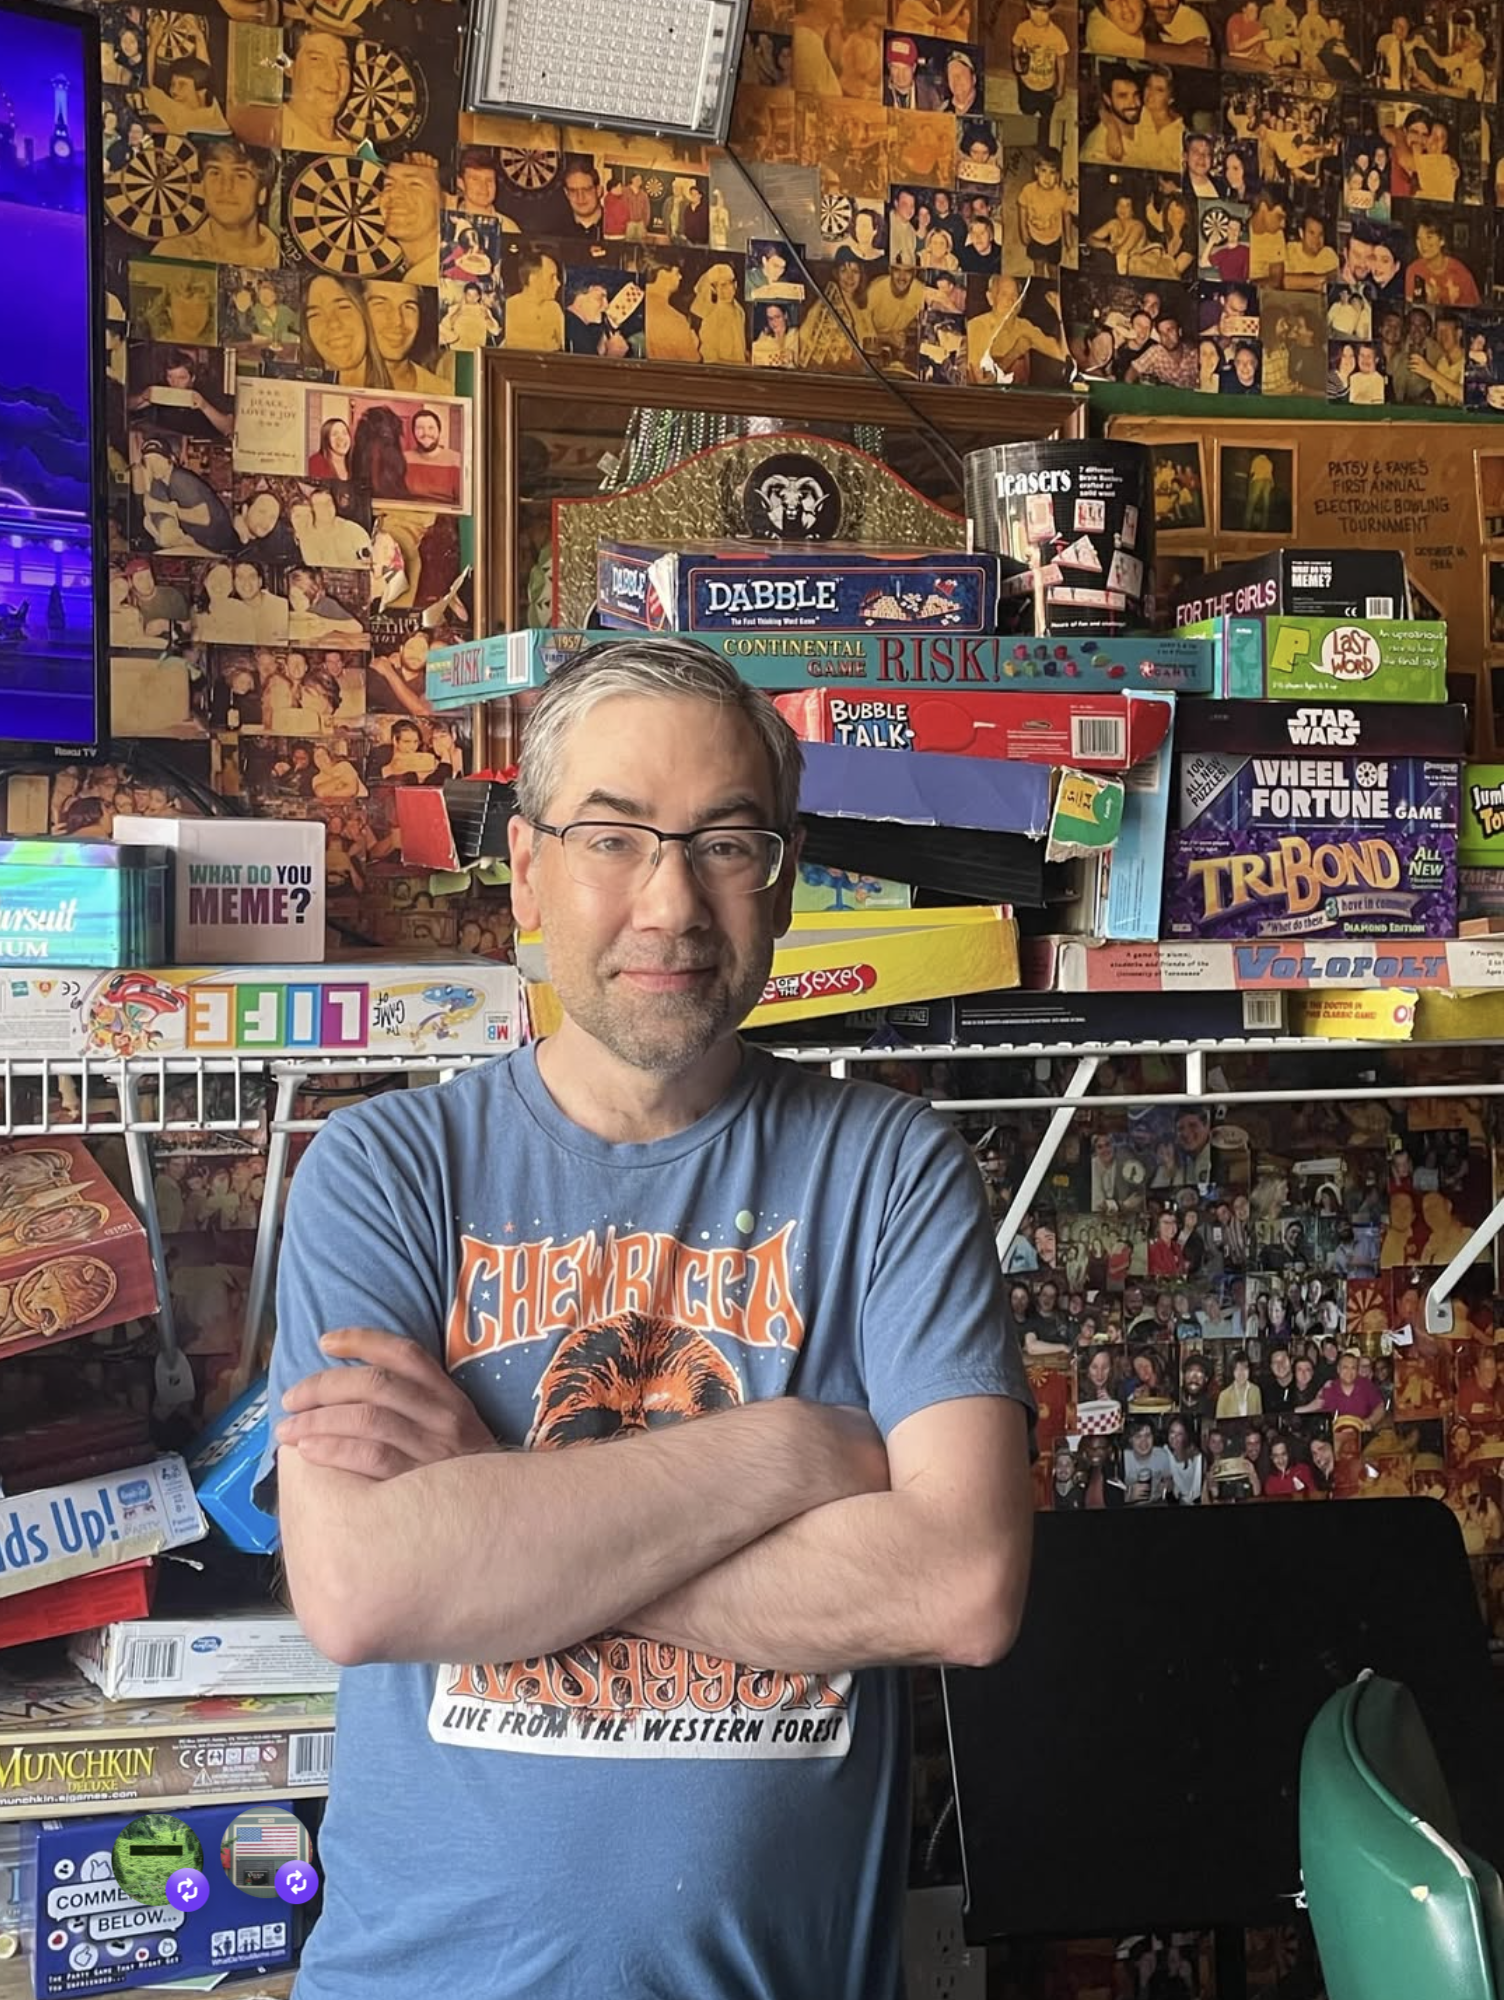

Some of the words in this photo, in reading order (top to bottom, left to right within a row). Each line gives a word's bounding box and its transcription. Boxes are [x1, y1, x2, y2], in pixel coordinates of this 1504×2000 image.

[1328, 461, 1369, 477] PATSY
[994, 469, 1072, 498] Teasers
[1333, 479, 1369, 495] FIRST
[1370, 478, 1427, 494] ANNUAL
[1314, 499, 1393, 515] ELECTRONIC
[1395, 496, 1450, 515] BOWLING
[1338, 515, 1430, 534] TOURNAMENT
[612, 566, 648, 600] DABBLE
[1291, 574, 1332, 588] MEME?
[708, 577, 837, 613] DABBLE
[1176, 600, 1203, 628] FOR
[1205, 592, 1233, 618] THE
[1235, 579, 1277, 613] GIRLS
[723, 638, 867, 657] CONTINENTAL
[876, 637, 1000, 683] RISK!
[807, 659, 867, 677] GAME
[1331, 655, 1373, 675] WORD
[830, 699, 908, 723] BUBBLE
[1288, 708, 1358, 728] STAR
[837, 722, 911, 748] TALK
[1287, 726, 1361, 746] WARS
[55, 747, 80, 757] Roku
[83, 748, 97, 758] TV
[1185, 775, 1203, 798] ALL
[1201, 757, 1223, 781] NEW
[1187, 758, 1205, 779] 100
[1252, 760, 1349, 787] WHEEL
[1191, 764, 1230, 807] PUZZLES!
[1252, 788, 1390, 818] FORTUNE
[1395, 806, 1443, 820] GAME
[1480, 807, 1504, 835] To
[1414, 846, 1442, 861] ALL
[189, 865, 243, 885] WHAT
[247, 865, 272, 885] DO
[276, 865, 312, 885] YOU
[1187, 836, 1400, 919] TRIBOND
[1408, 861, 1445, 876] NEW
[189, 888, 312, 925] MEME?
[1293, 919, 1303, 930] do
[1304, 915, 1324, 929] these
[1325, 897, 1339, 919] 3
[1341, 899, 1363, 912] have
[1364, 898, 1373, 910] in
[1344, 922, 1388, 933] DIAMOND
[1389, 922, 1426, 933] EDITION
[1234, 946, 1447, 980] VOLOPOLY
[192, 990, 362, 1045] LIFE
[488, 1025, 508, 1040] MB
[50, 1488, 119, 1559] Up!
[443, 1705, 493, 1733] LIVE
[498, 1711, 568, 1739] FROM
[581, 1716, 635, 1743] THE
[643, 1717, 762, 1743] WESTERN
[771, 1716, 842, 1744] FOREST
[0, 1746, 157, 1788] MUNCHKIN
[67, 1780, 118, 1793] DELUXE
[56, 1888, 133, 1910] COMME
[99, 1909, 177, 1932] BELOW...
